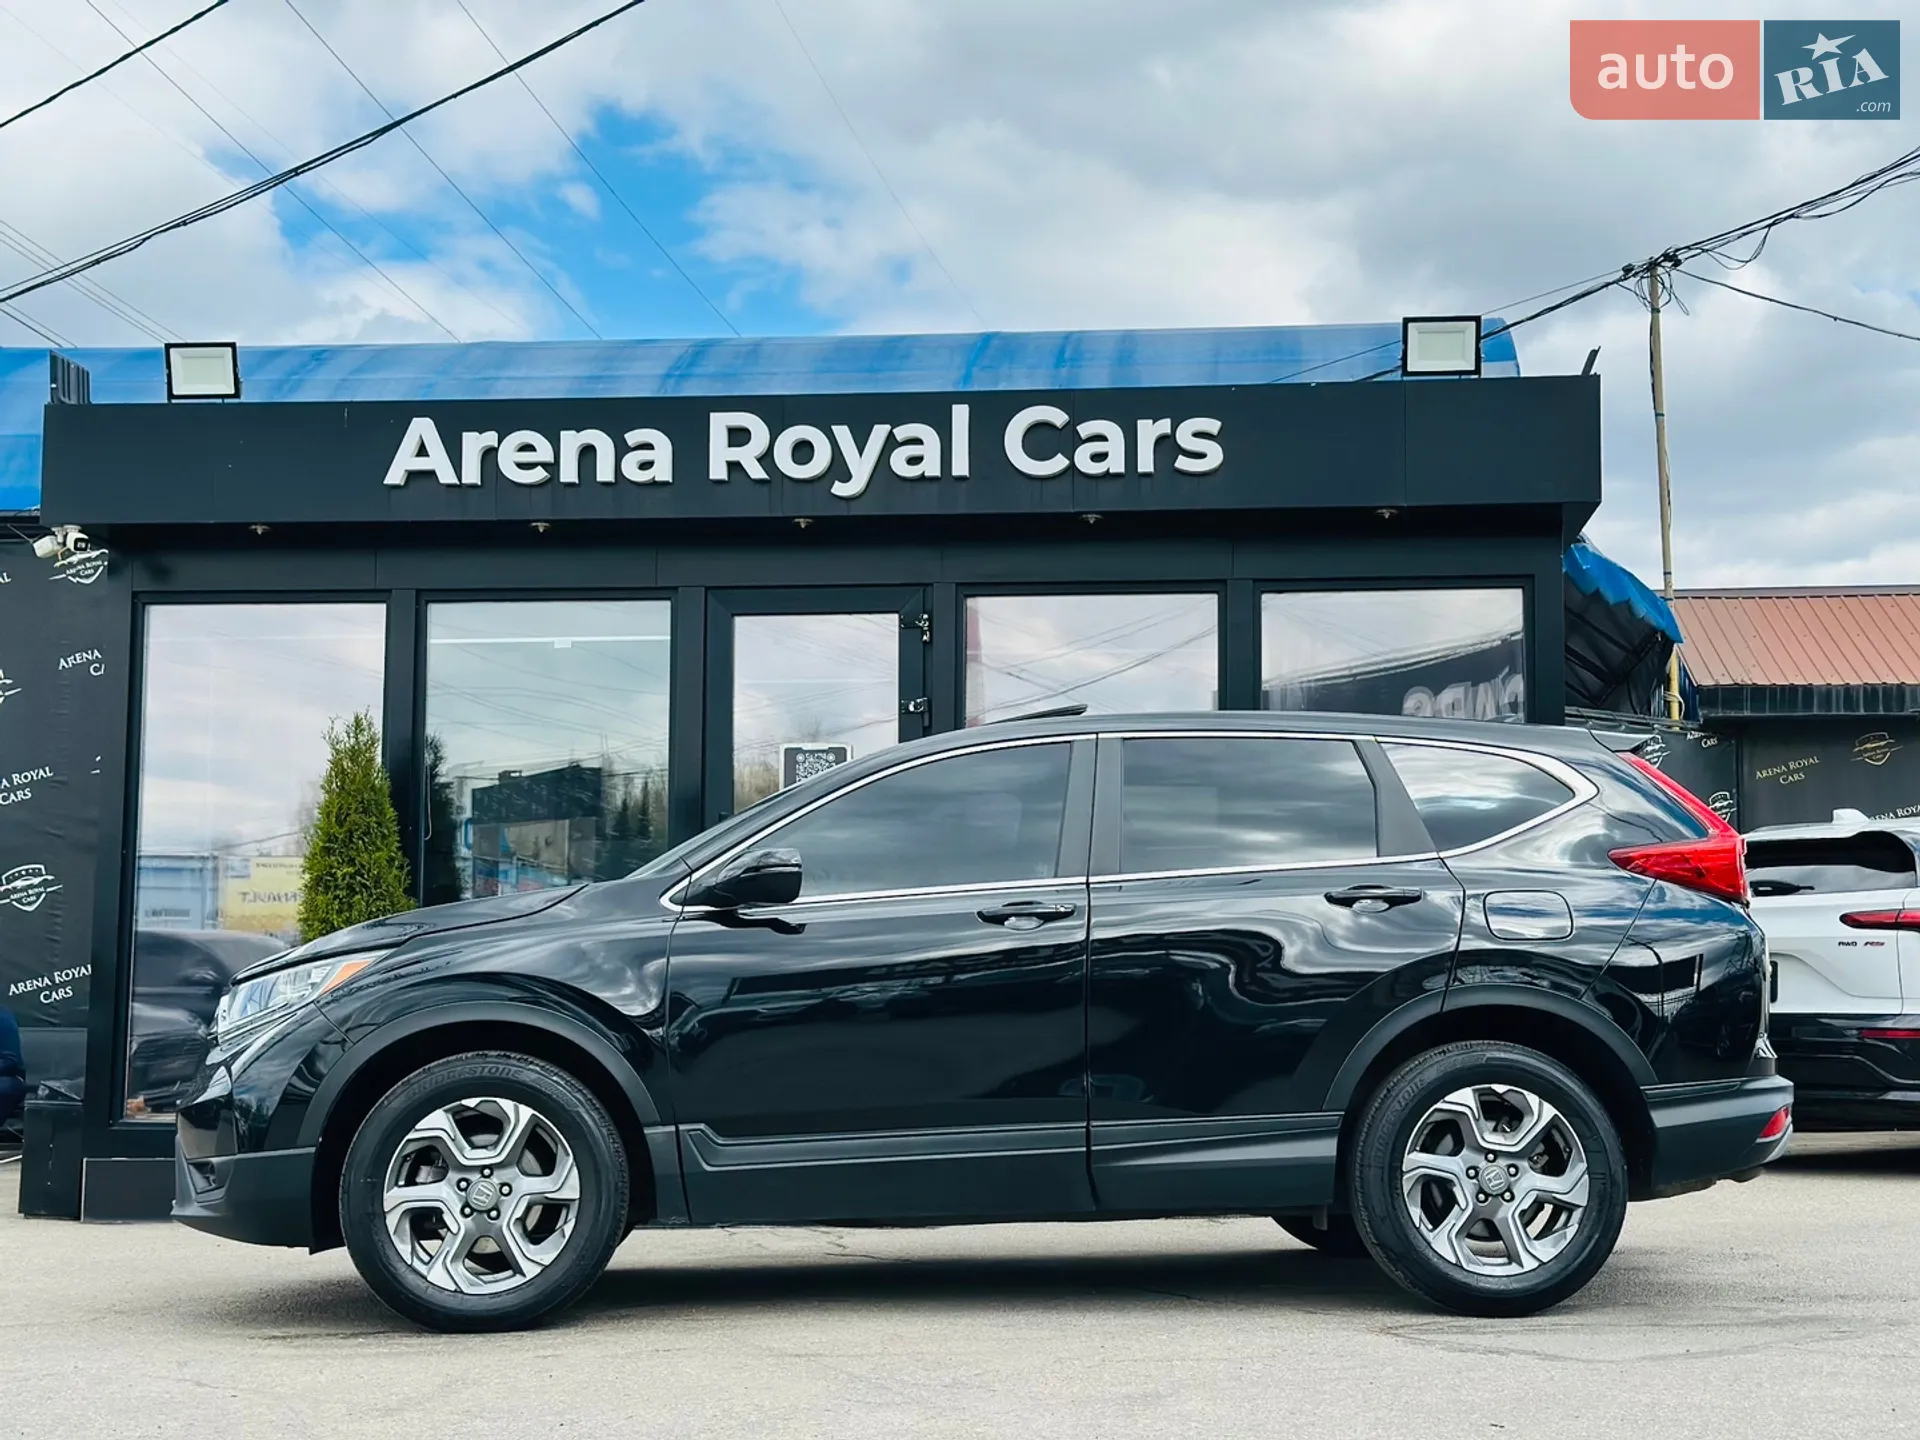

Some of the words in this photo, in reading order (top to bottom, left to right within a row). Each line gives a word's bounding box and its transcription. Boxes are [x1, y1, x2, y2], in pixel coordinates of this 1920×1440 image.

[383, 416, 673, 486] Arena
[708, 403, 970, 499] Royal
[1003, 405, 1225, 478] Cars
[58, 648, 102, 671] ARENA
[11, 766, 54, 786] ROYAL
[1755, 765, 1788, 780] ARENA
[1788, 755, 1821, 771] ROYAL
[1779, 771, 1806, 785] CARS
[0, 788, 32, 805] CARS
[8, 976, 52, 996] ARENA
[39, 986, 74, 1004] CARS
